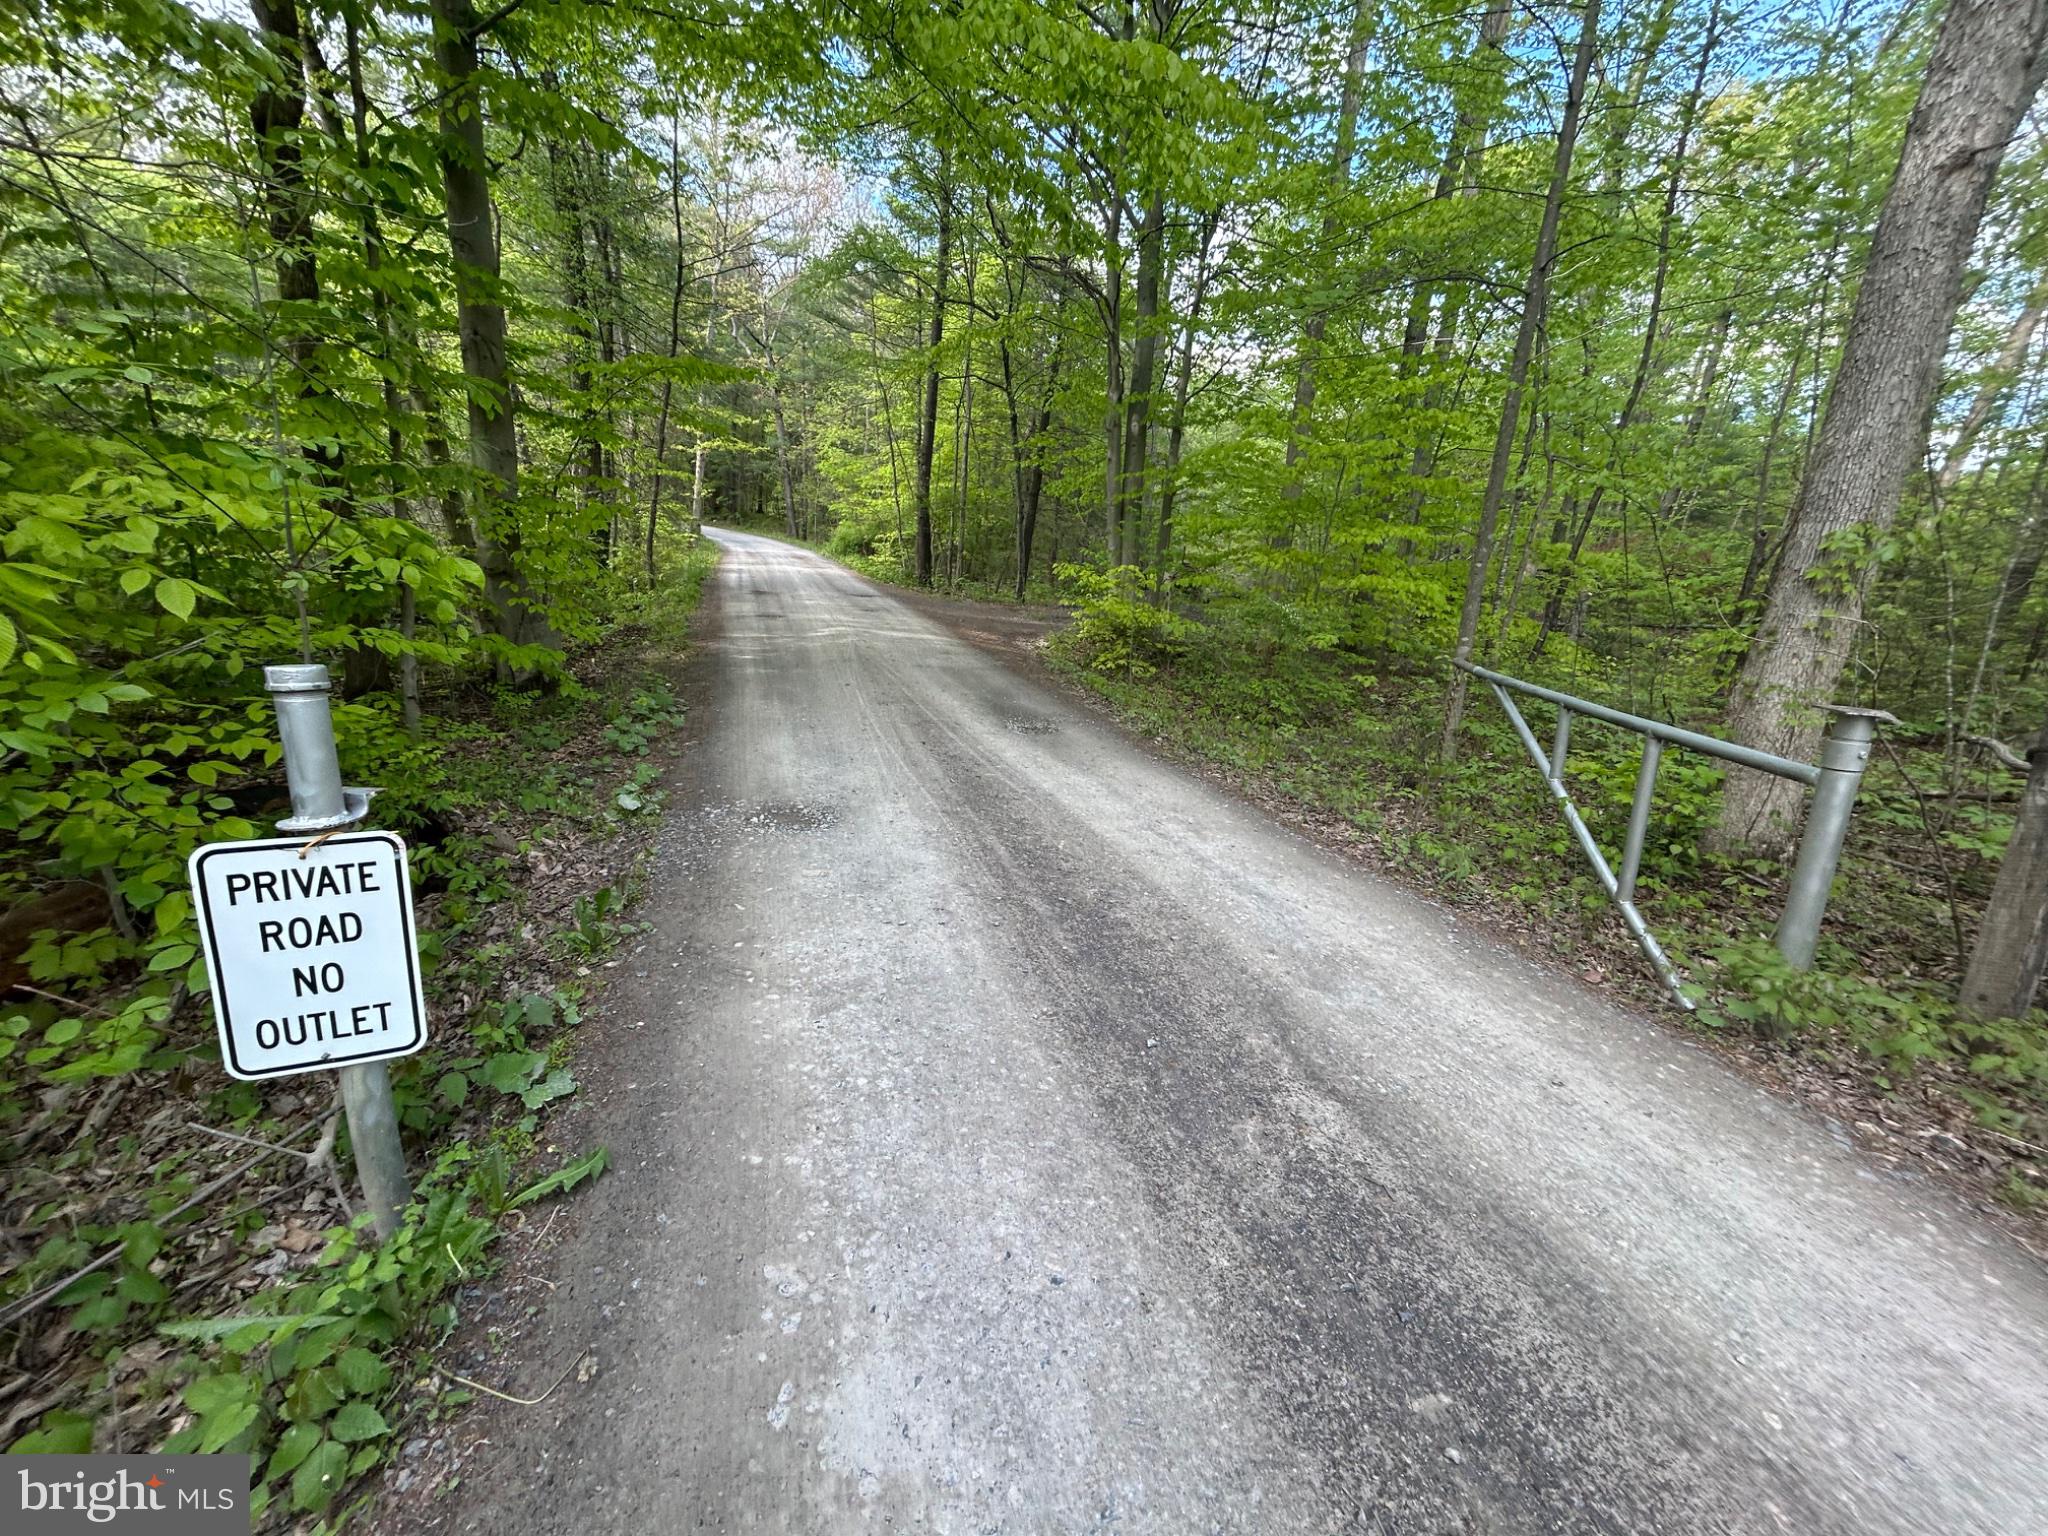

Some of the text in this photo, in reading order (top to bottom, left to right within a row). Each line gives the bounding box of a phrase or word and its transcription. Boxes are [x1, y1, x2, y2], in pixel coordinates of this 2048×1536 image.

[226, 861, 380, 906] PRIVATE
[260, 912, 363, 952] ROAD
[292, 962, 345, 997] NO
[255, 1002, 392, 1049] OUTLET
